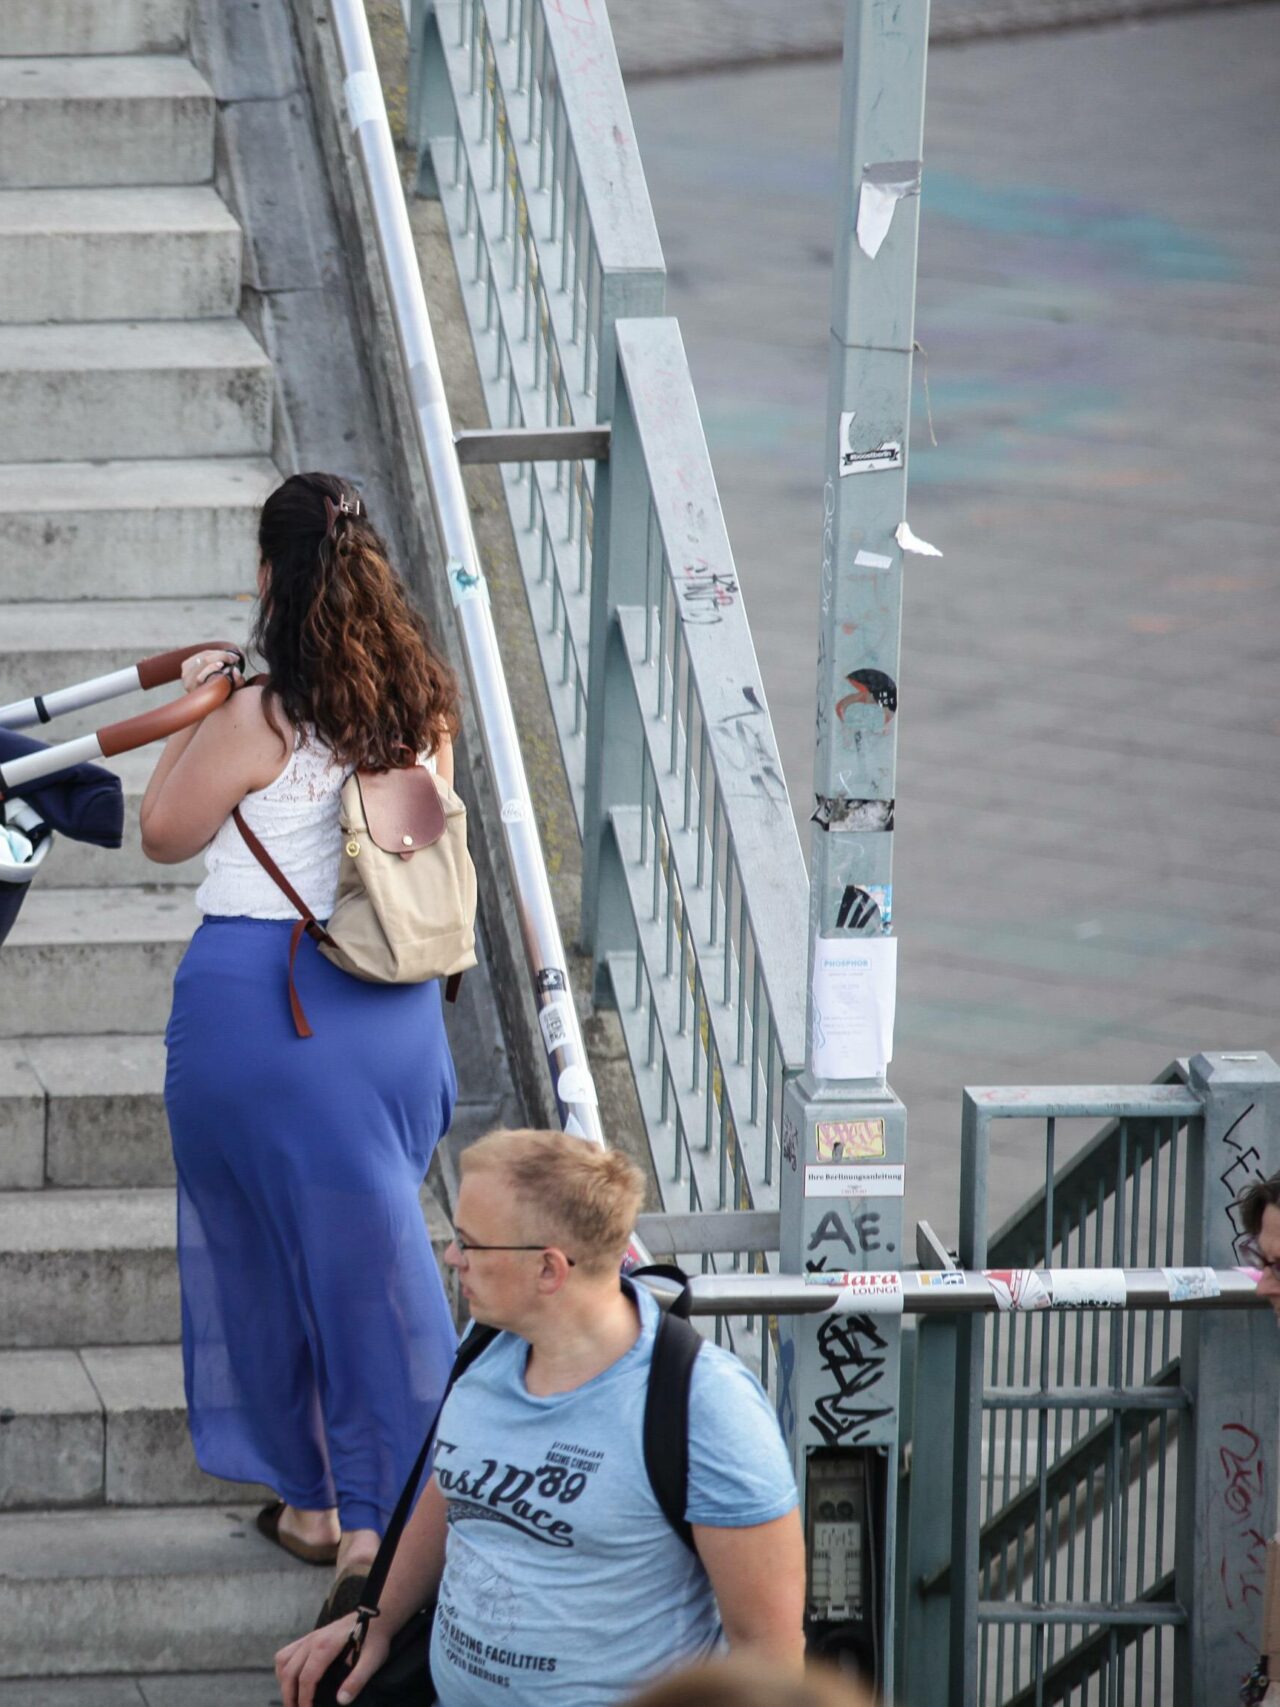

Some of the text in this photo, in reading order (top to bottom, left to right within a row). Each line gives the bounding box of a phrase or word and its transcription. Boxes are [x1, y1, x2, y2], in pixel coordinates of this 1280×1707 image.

[823, 959, 870, 968] PHOSPHOR
[852, 1286, 899, 1296] LOUNGE
[488, 1464, 574, 1543] Pace
[485, 1644, 558, 1673] FACILITIES
